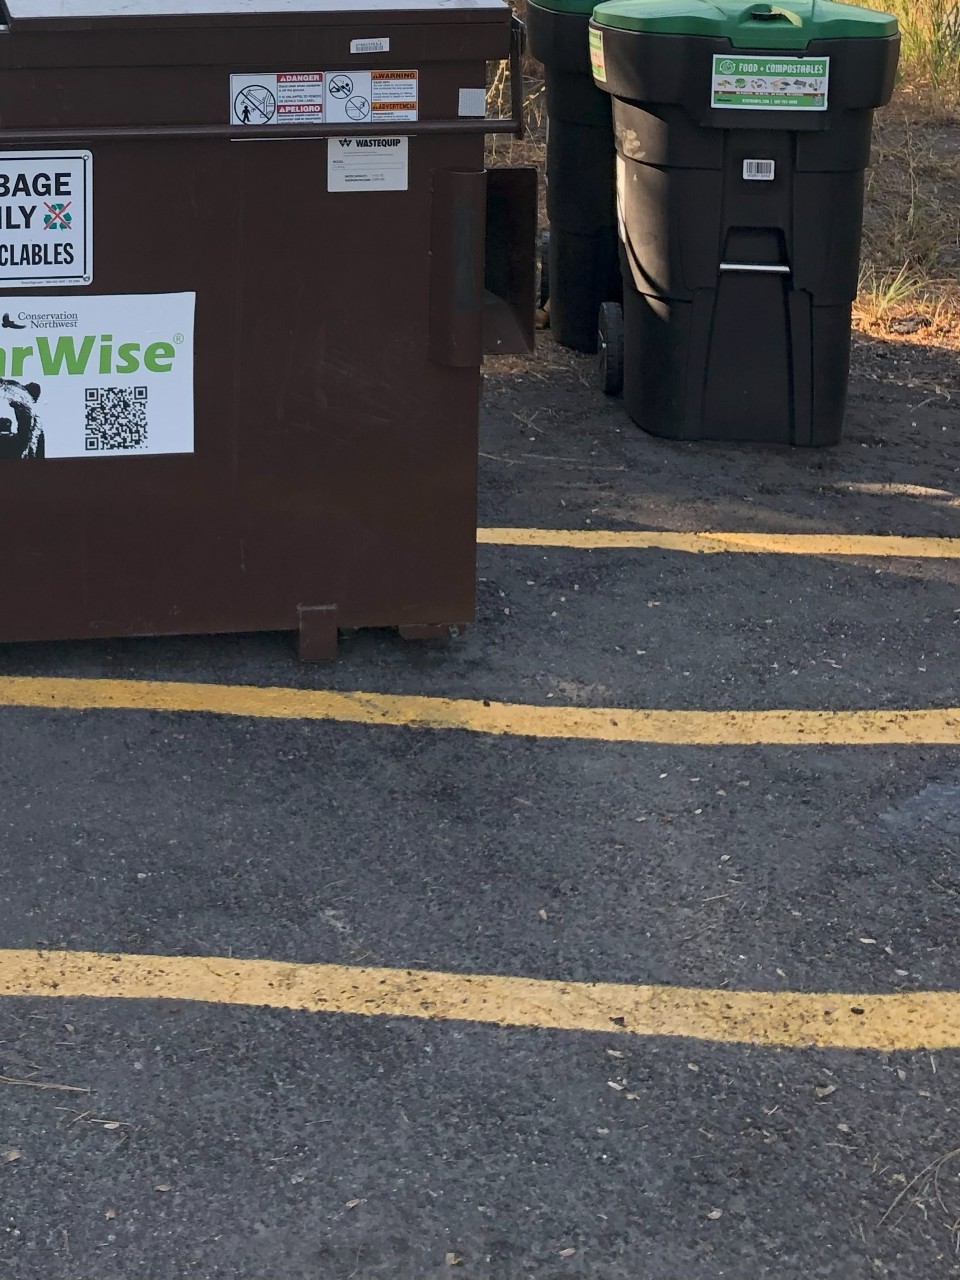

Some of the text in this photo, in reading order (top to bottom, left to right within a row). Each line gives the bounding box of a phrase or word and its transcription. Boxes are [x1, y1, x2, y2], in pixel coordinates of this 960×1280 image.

[739, 63, 758, 73] FOOD
[766, 63, 823, 74] COMPOSTABLES
[286, 74, 320, 82] DANGER
[285, 105, 321, 113] PELIGRO
[356, 138, 401, 148] WASTEQUIP
[17, 311, 79, 321] Conservation
[30, 320, 78, 329] Northwest
